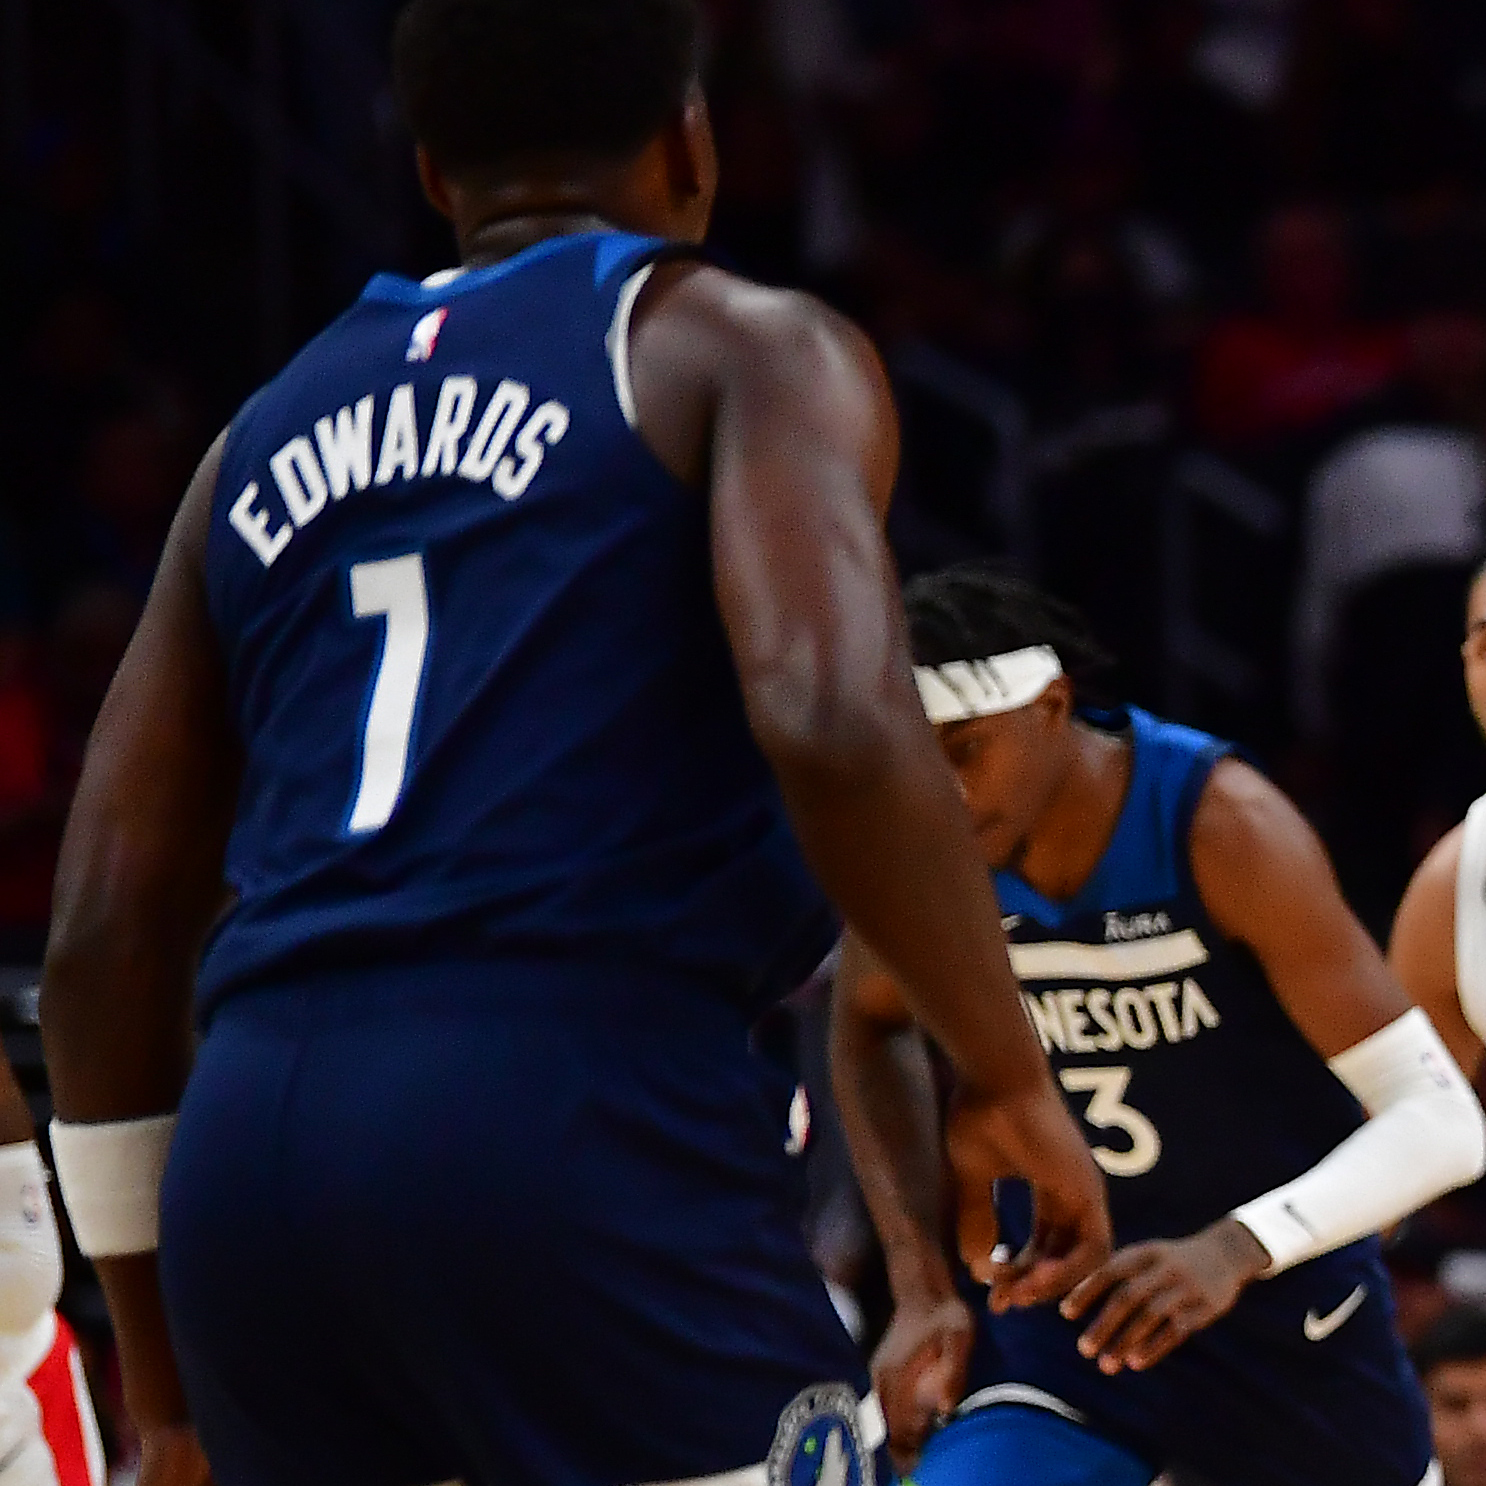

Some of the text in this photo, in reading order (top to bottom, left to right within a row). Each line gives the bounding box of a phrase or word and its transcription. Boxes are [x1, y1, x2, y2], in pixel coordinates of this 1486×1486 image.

[228, 374, 571, 568] EDWARDS
[348, 552, 431, 835] 1
[1058, 1065, 1163, 1178] 3
